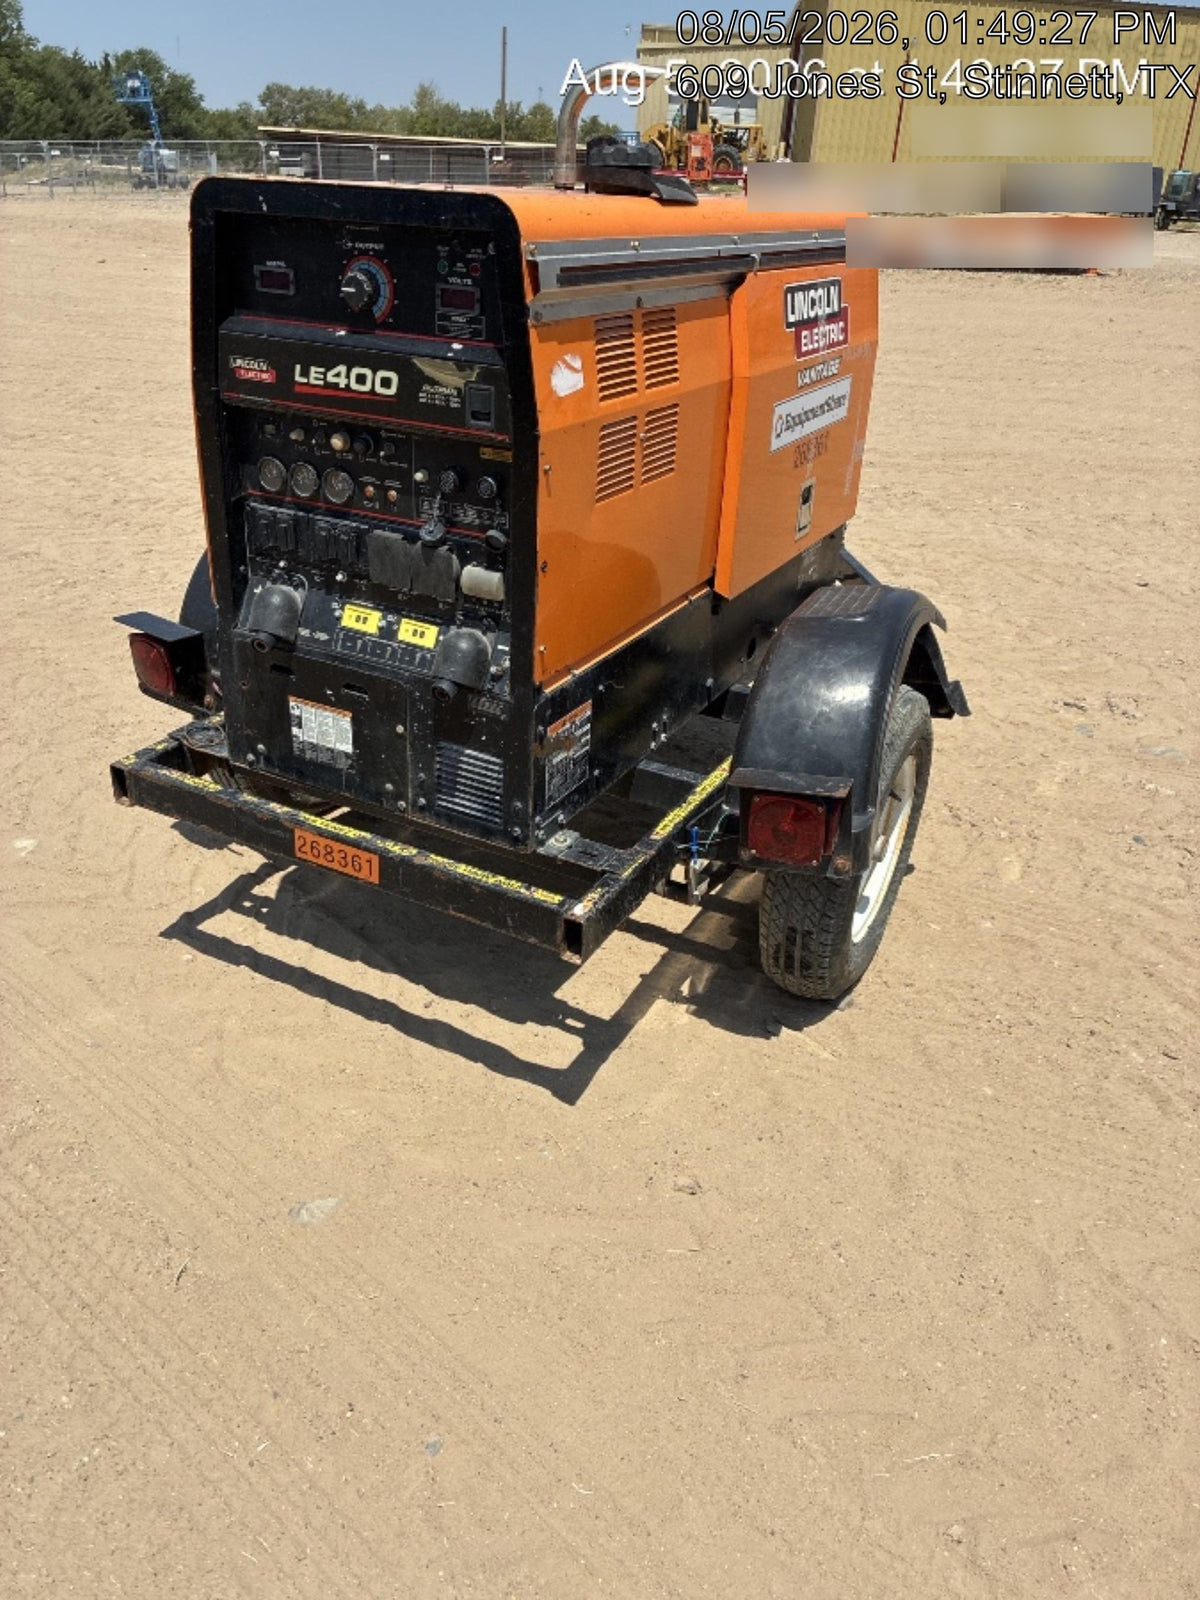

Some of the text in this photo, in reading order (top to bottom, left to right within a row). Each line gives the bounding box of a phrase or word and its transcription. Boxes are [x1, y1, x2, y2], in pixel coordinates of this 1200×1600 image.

[787, 284, 839, 323] LINCOLN
[801, 321, 845, 352] ELECTRIC
[230, 356, 269, 371] LINCOLN
[294, 363, 399, 396] LE400
[296, 834, 374, 879] 268361
